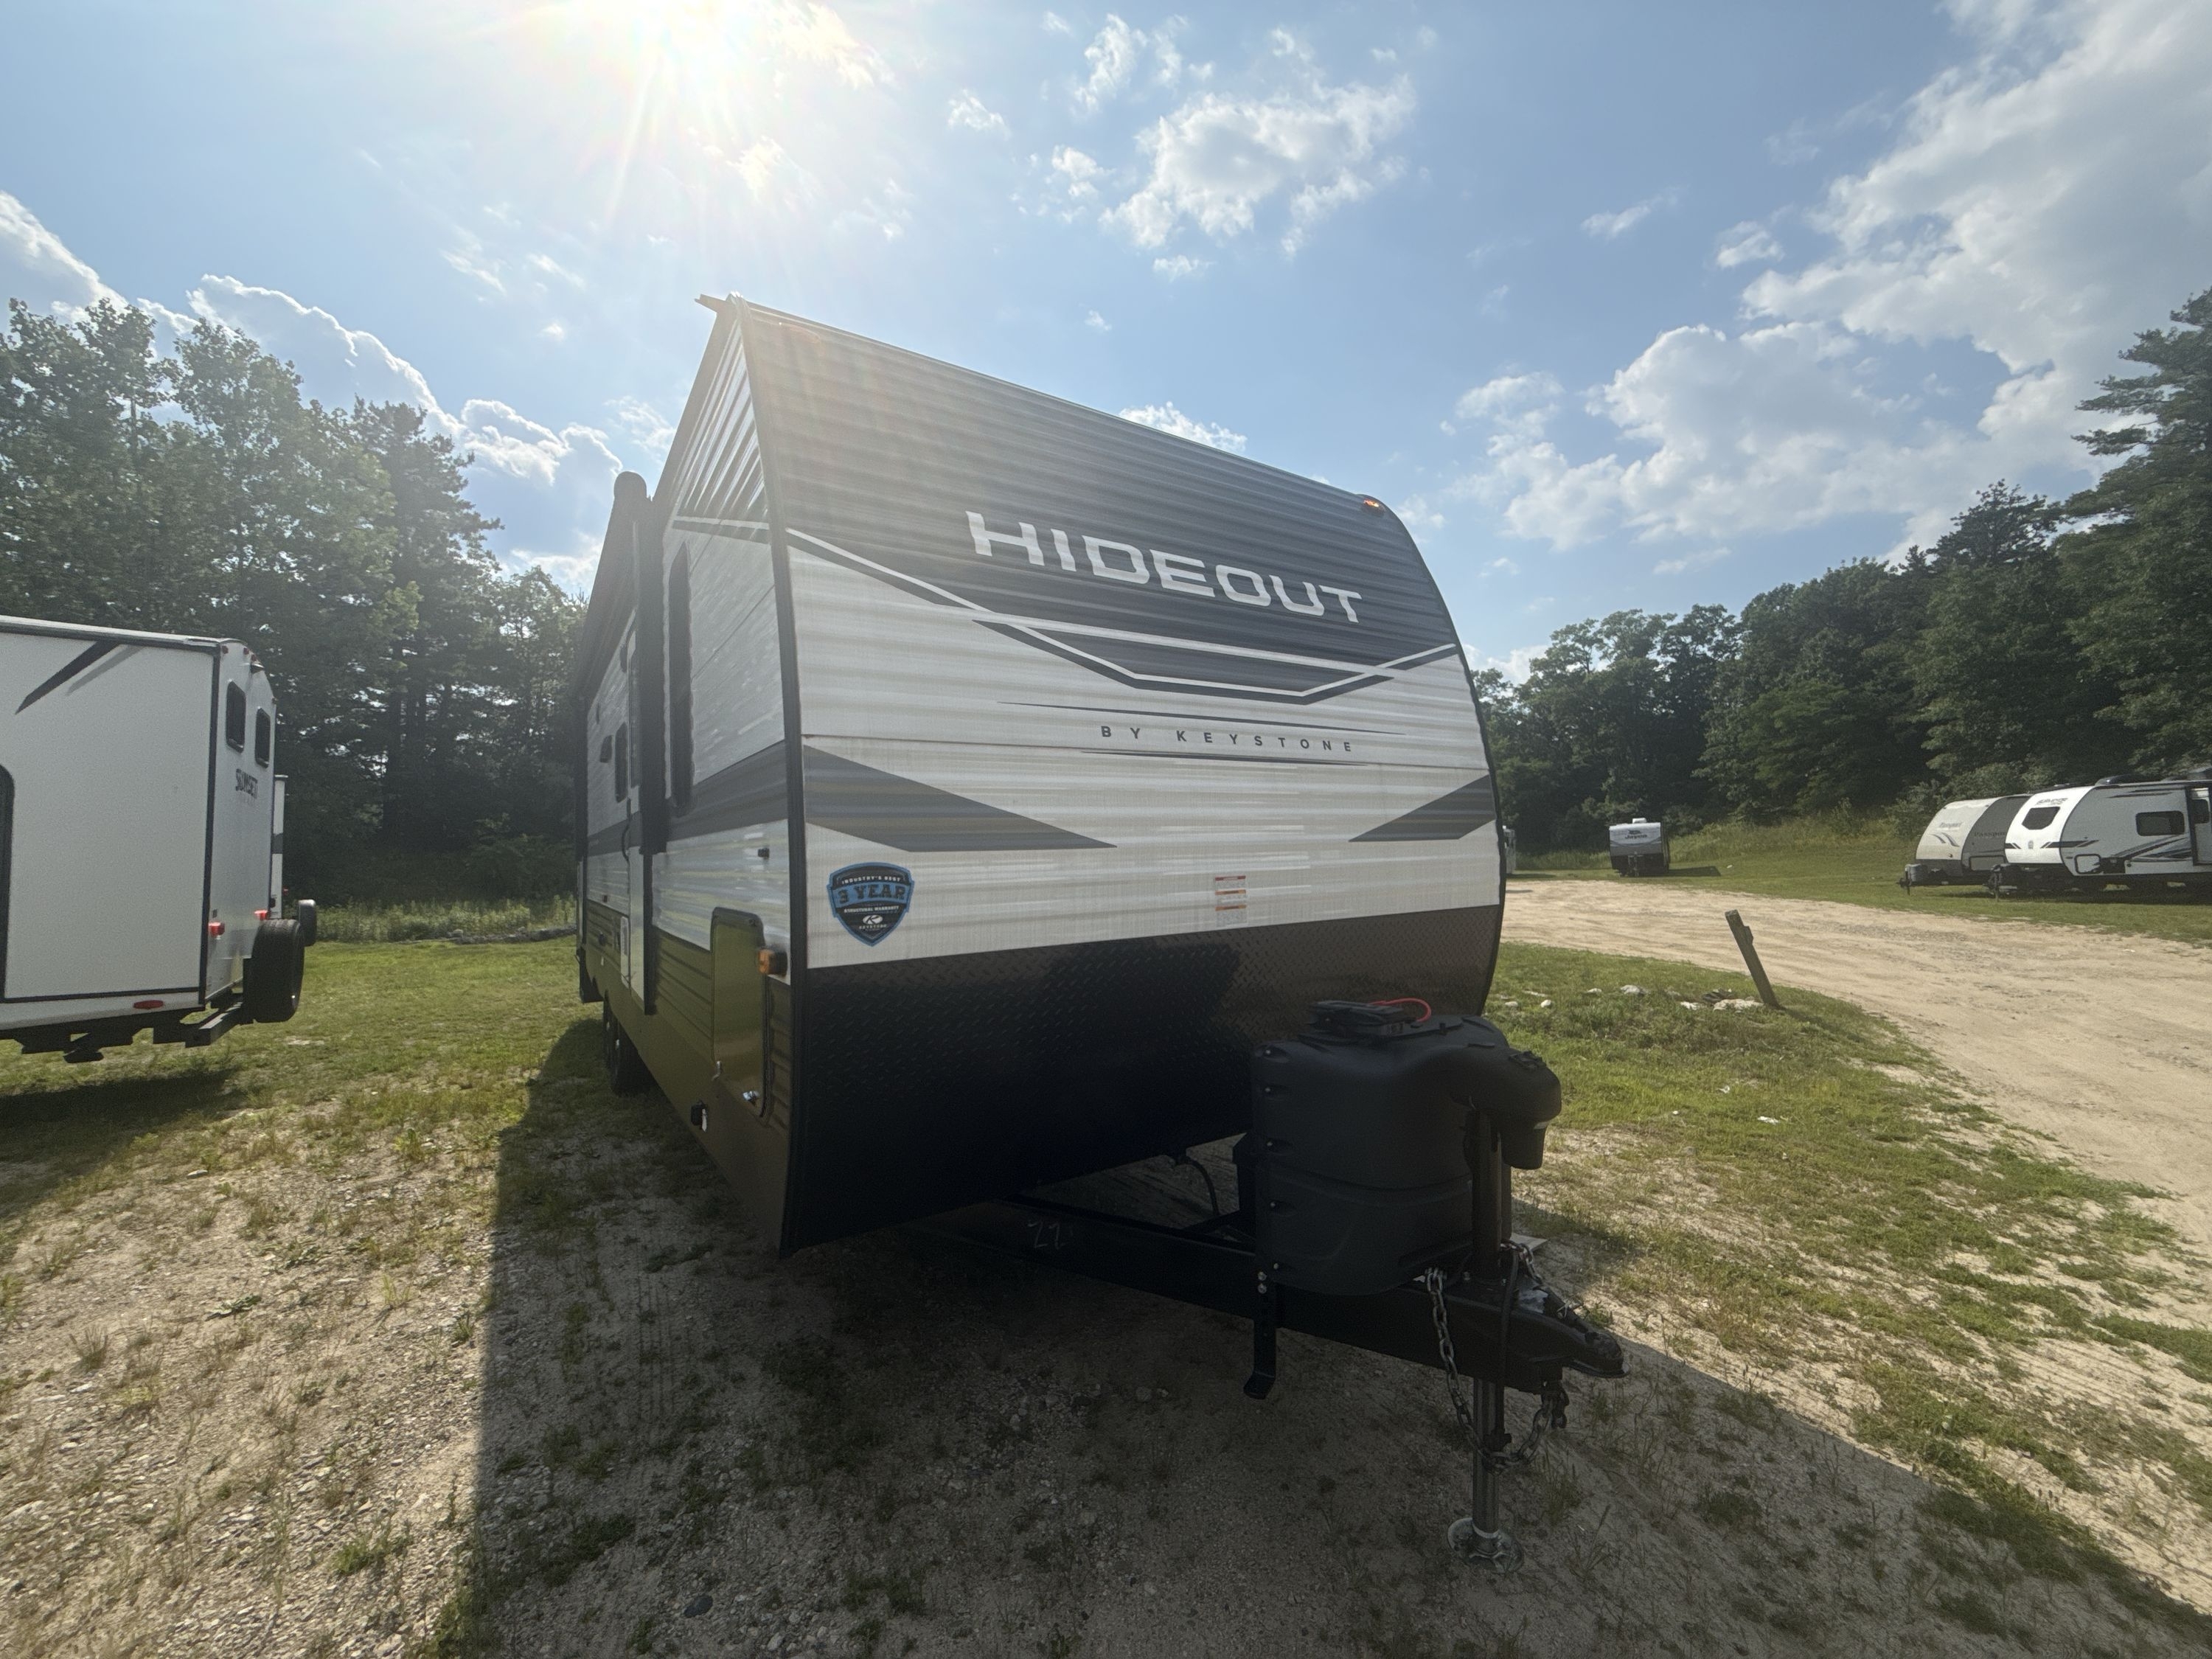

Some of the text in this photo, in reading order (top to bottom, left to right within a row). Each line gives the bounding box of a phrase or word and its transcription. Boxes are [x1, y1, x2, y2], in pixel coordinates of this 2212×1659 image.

[966, 511, 1362, 623] HIDEOUT
[1101, 726, 1352, 752] BY KEYSTONE
[842, 876, 882, 884] INDUSTRY'S
[854, 885, 905, 900] YEAR
